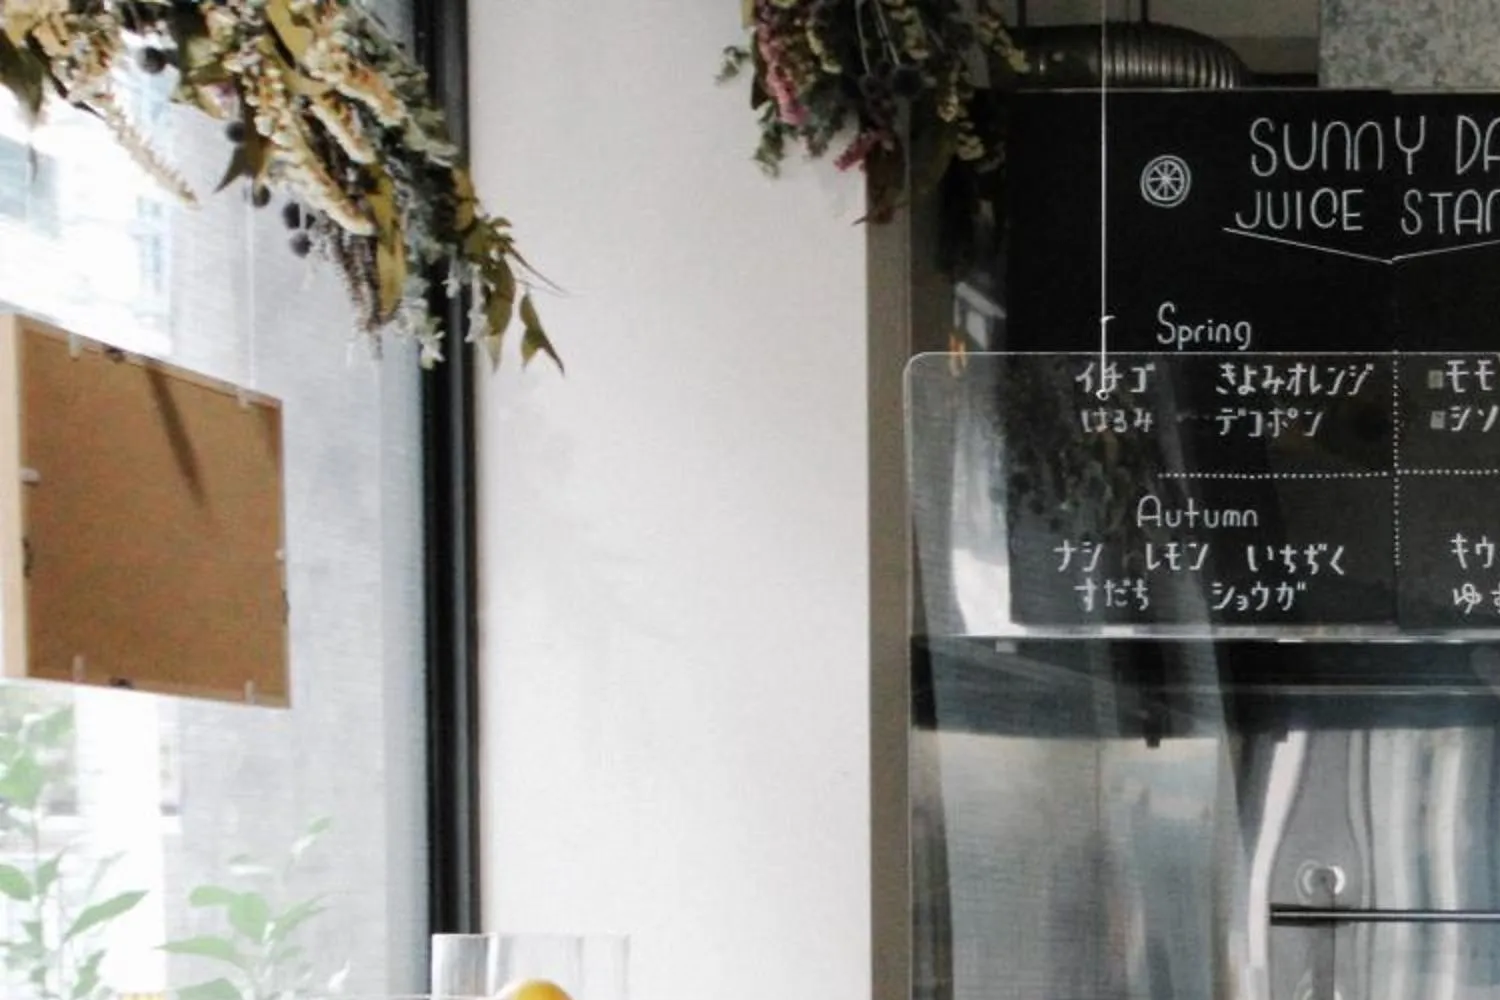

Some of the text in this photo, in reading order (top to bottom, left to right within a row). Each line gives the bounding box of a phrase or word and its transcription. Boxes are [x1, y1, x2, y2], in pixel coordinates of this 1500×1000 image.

[1249, 114, 1425, 177] SUNNY
[1235, 187, 1364, 231] JUICE
[1156, 301, 1252, 350] Spring
[1216, 362, 1375, 396] きよみオレンジ
[1081, 407, 1324, 437] はるみ デコポン
[1136, 494, 1259, 528] Autumn
[1052, 539, 1104, 573] ナシ
[1145, 541, 1210, 572] レモン
[1073, 576, 1150, 613] すだち
